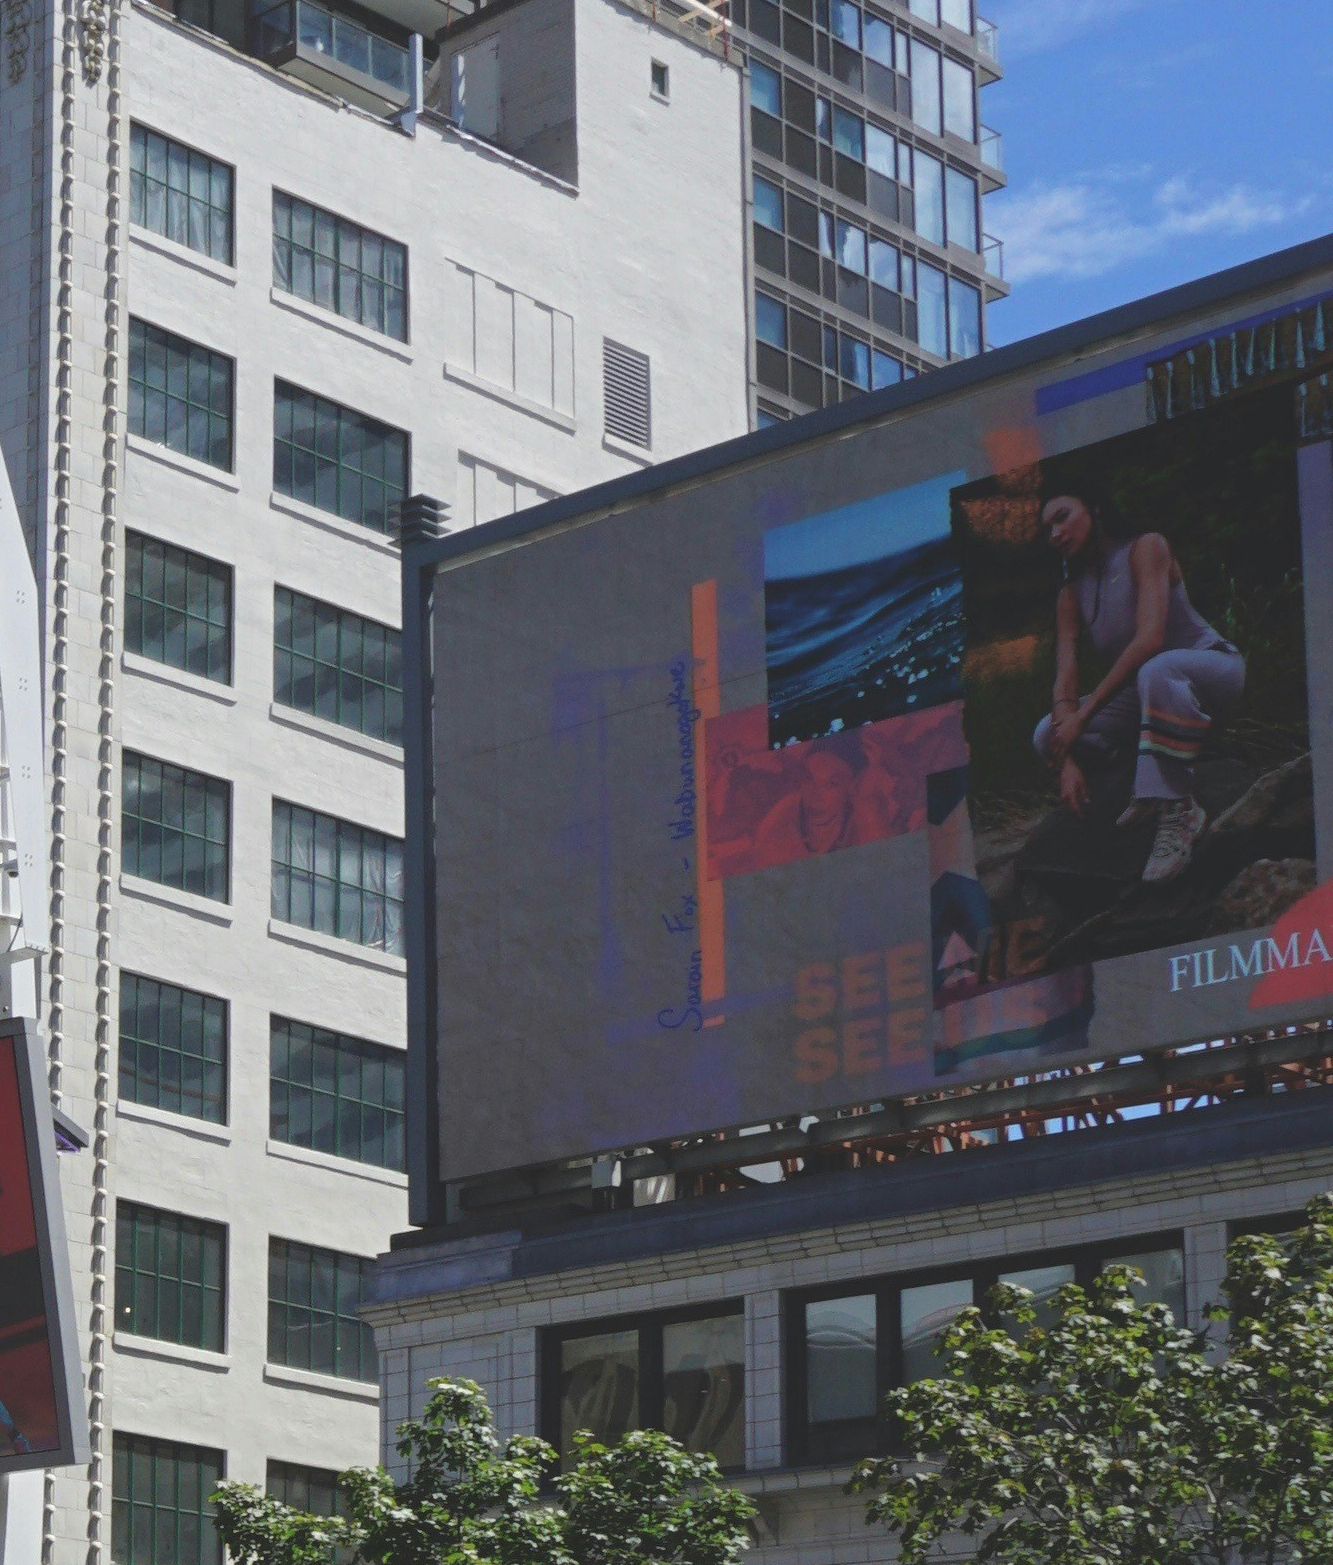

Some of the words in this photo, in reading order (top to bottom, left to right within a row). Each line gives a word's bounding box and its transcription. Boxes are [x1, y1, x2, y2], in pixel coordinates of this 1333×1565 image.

[661, 894, 697, 935] Fox
[793, 941, 930, 1021] SEE
[793, 1006, 927, 1085] SEE
